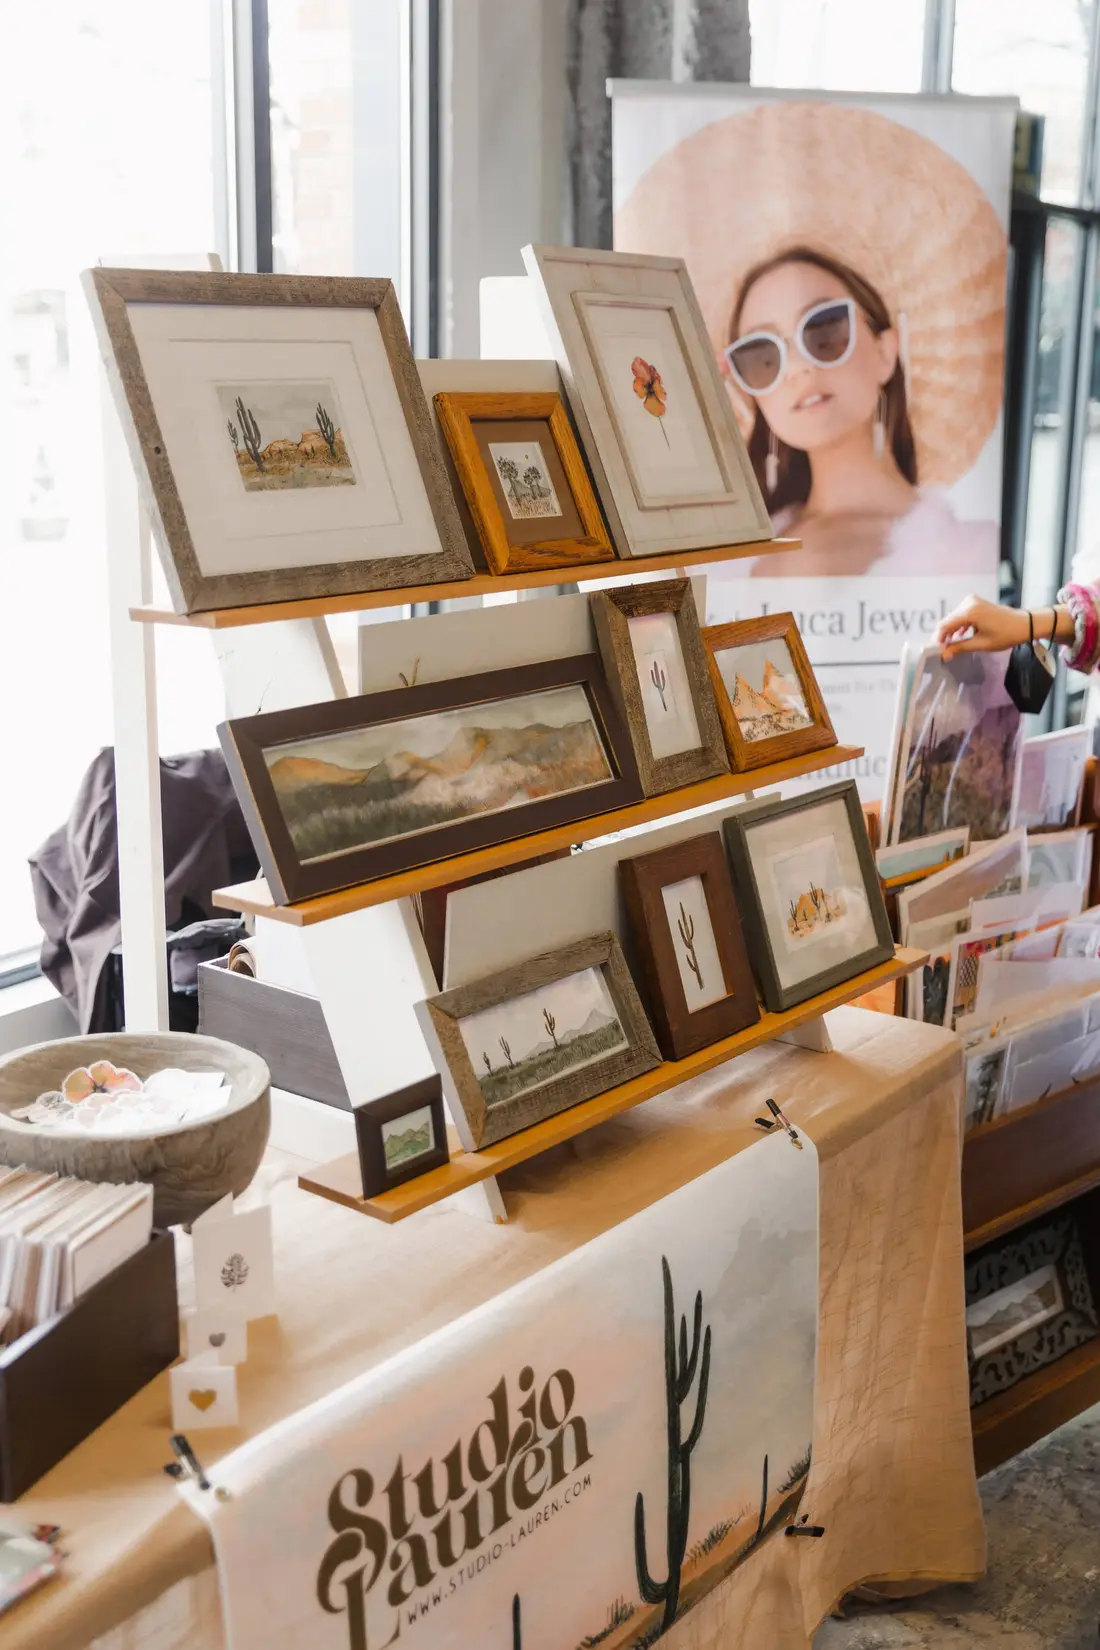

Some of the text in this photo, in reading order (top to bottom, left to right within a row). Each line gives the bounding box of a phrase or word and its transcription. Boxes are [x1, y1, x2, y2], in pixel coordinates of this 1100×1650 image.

[316, 1415, 594, 1650] Lauren
[328, 1365, 575, 1594] Studio
[407, 1473, 593, 1625] WWW.STUDIO-LAUREN.COM
